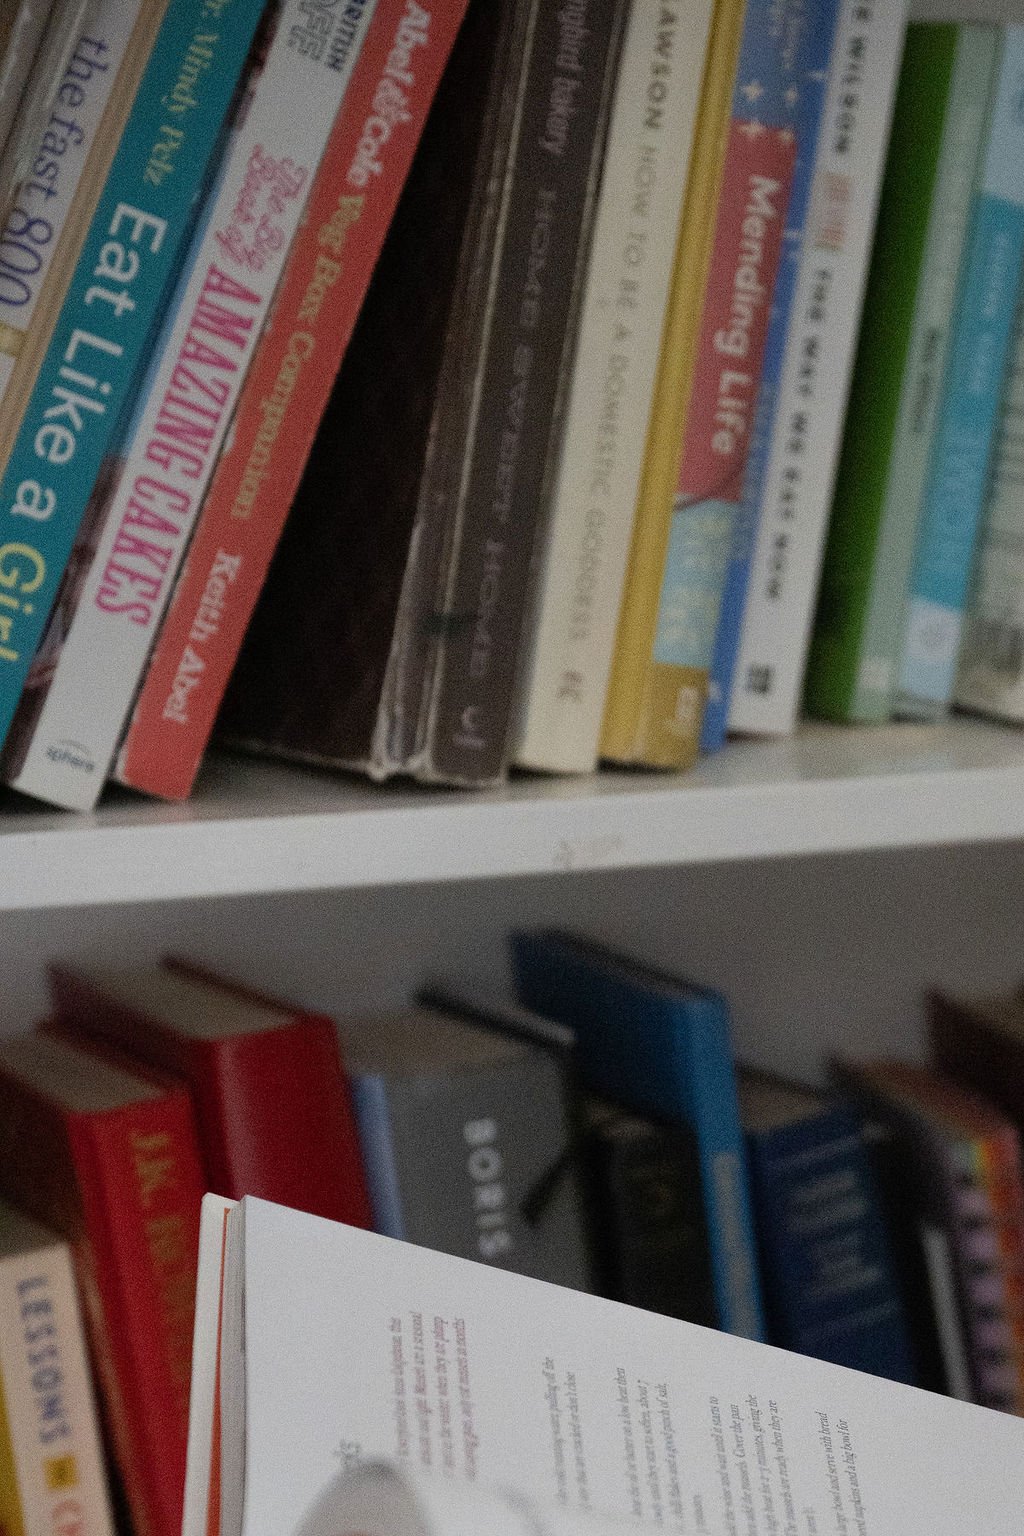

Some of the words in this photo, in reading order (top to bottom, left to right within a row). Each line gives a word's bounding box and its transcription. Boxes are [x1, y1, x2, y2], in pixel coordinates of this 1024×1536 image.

[58, 32, 114, 114] the
[169, 35, 218, 113] Mindy
[144, 126, 183, 184] Pelz
[540, 77, 580, 155] bakery
[22, 109, 82, 207] fast
[233, 145, 277, 223] Book
[269, 159, 307, 213] The
[633, 146, 656, 216] HOW
[0, 204, 52, 305] 800
[85, 204, 166, 315] Eat
[215, 225, 247, 264] of
[238, 220, 283, 270] Big
[319, 195, 365, 253] Veg
[521, 191, 555, 327] HOME
[624, 233, 646, 266] TO
[298, 255, 340, 322] Box
[618, 279, 637, 307] BE
[713, 176, 778, 356] Mending
[146, 264, 261, 478] AMAZING
[613, 324, 630, 342] A
[35, 330, 122, 463] Like
[231, 332, 314, 519] Companion
[493, 346, 531, 522] SWEET
[592, 355, 628, 490] DOMESTIC
[712, 371, 748, 453] Life
[12, 481, 55, 520] a
[96, 477, 190, 625] CAKES
[571, 509, 604, 640] GODDESS
[190, 551, 240, 641] Keith
[470, 540, 504, 677] HOME
[164, 647, 204, 722] Abel
[17, 1278, 68, 1443] LESSONS
[733, 1431, 745, 1458] Cover
[750, 1408, 765, 1433] giving
[770, 1430, 784, 1454] when
[815, 1411, 830, 1435] bread
[827, 1454, 837, 1476] serve
